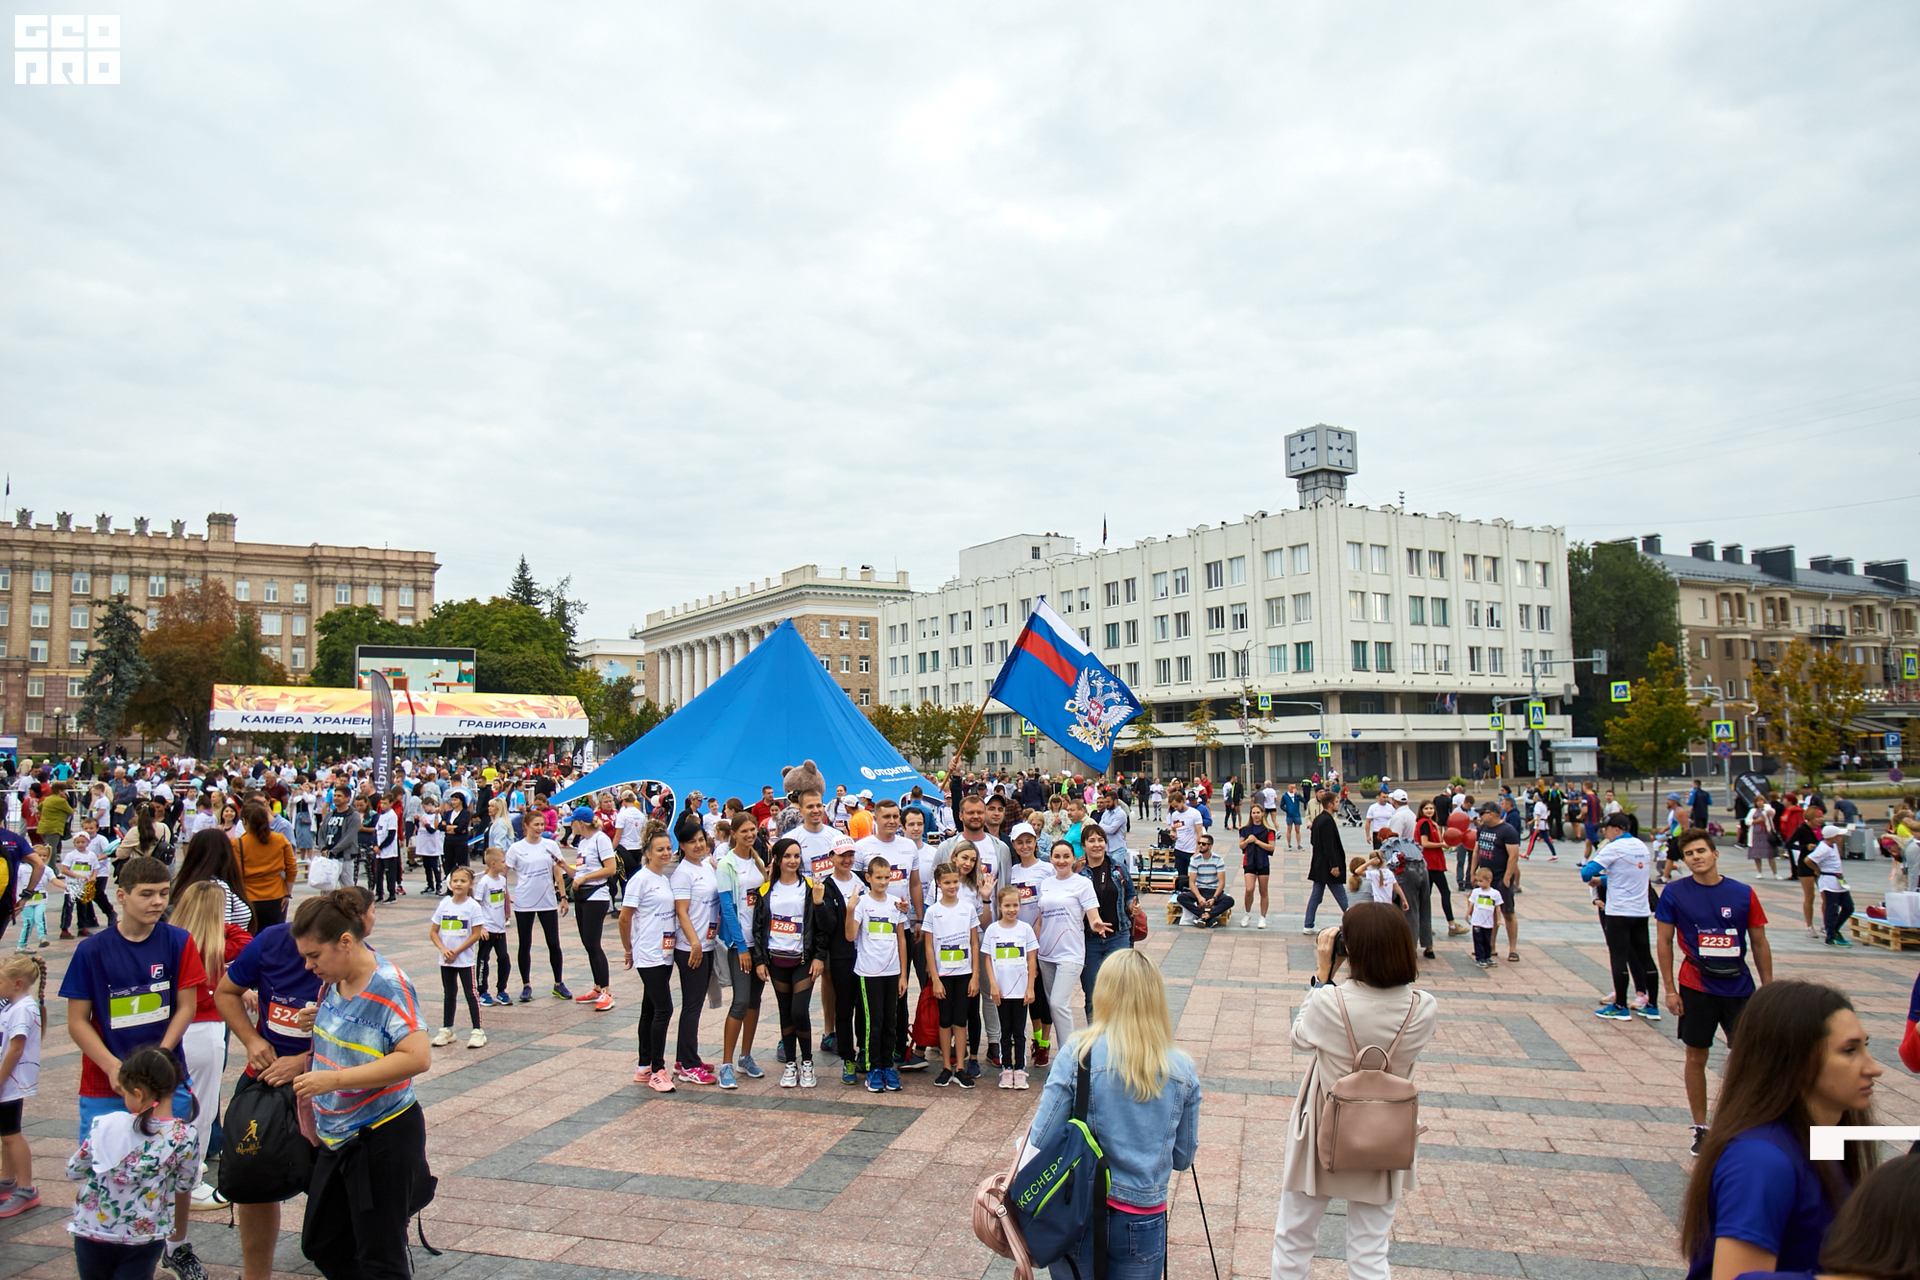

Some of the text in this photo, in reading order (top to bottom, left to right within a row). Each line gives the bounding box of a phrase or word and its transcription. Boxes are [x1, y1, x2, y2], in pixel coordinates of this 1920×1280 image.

[240, 715, 373, 726] КАМЕРА ХРАНЕН
[458, 719, 547, 730] ГРАВИРОВКА
[1889, 734, 1898, 746] P
[773, 921, 795, 932] 5286
[878, 923, 884, 933] 1
[1701, 936, 1731, 947] 2233
[949, 950, 955, 961] 1
[1004, 947, 1010, 959] 1
[130, 996, 140, 1014] 1
